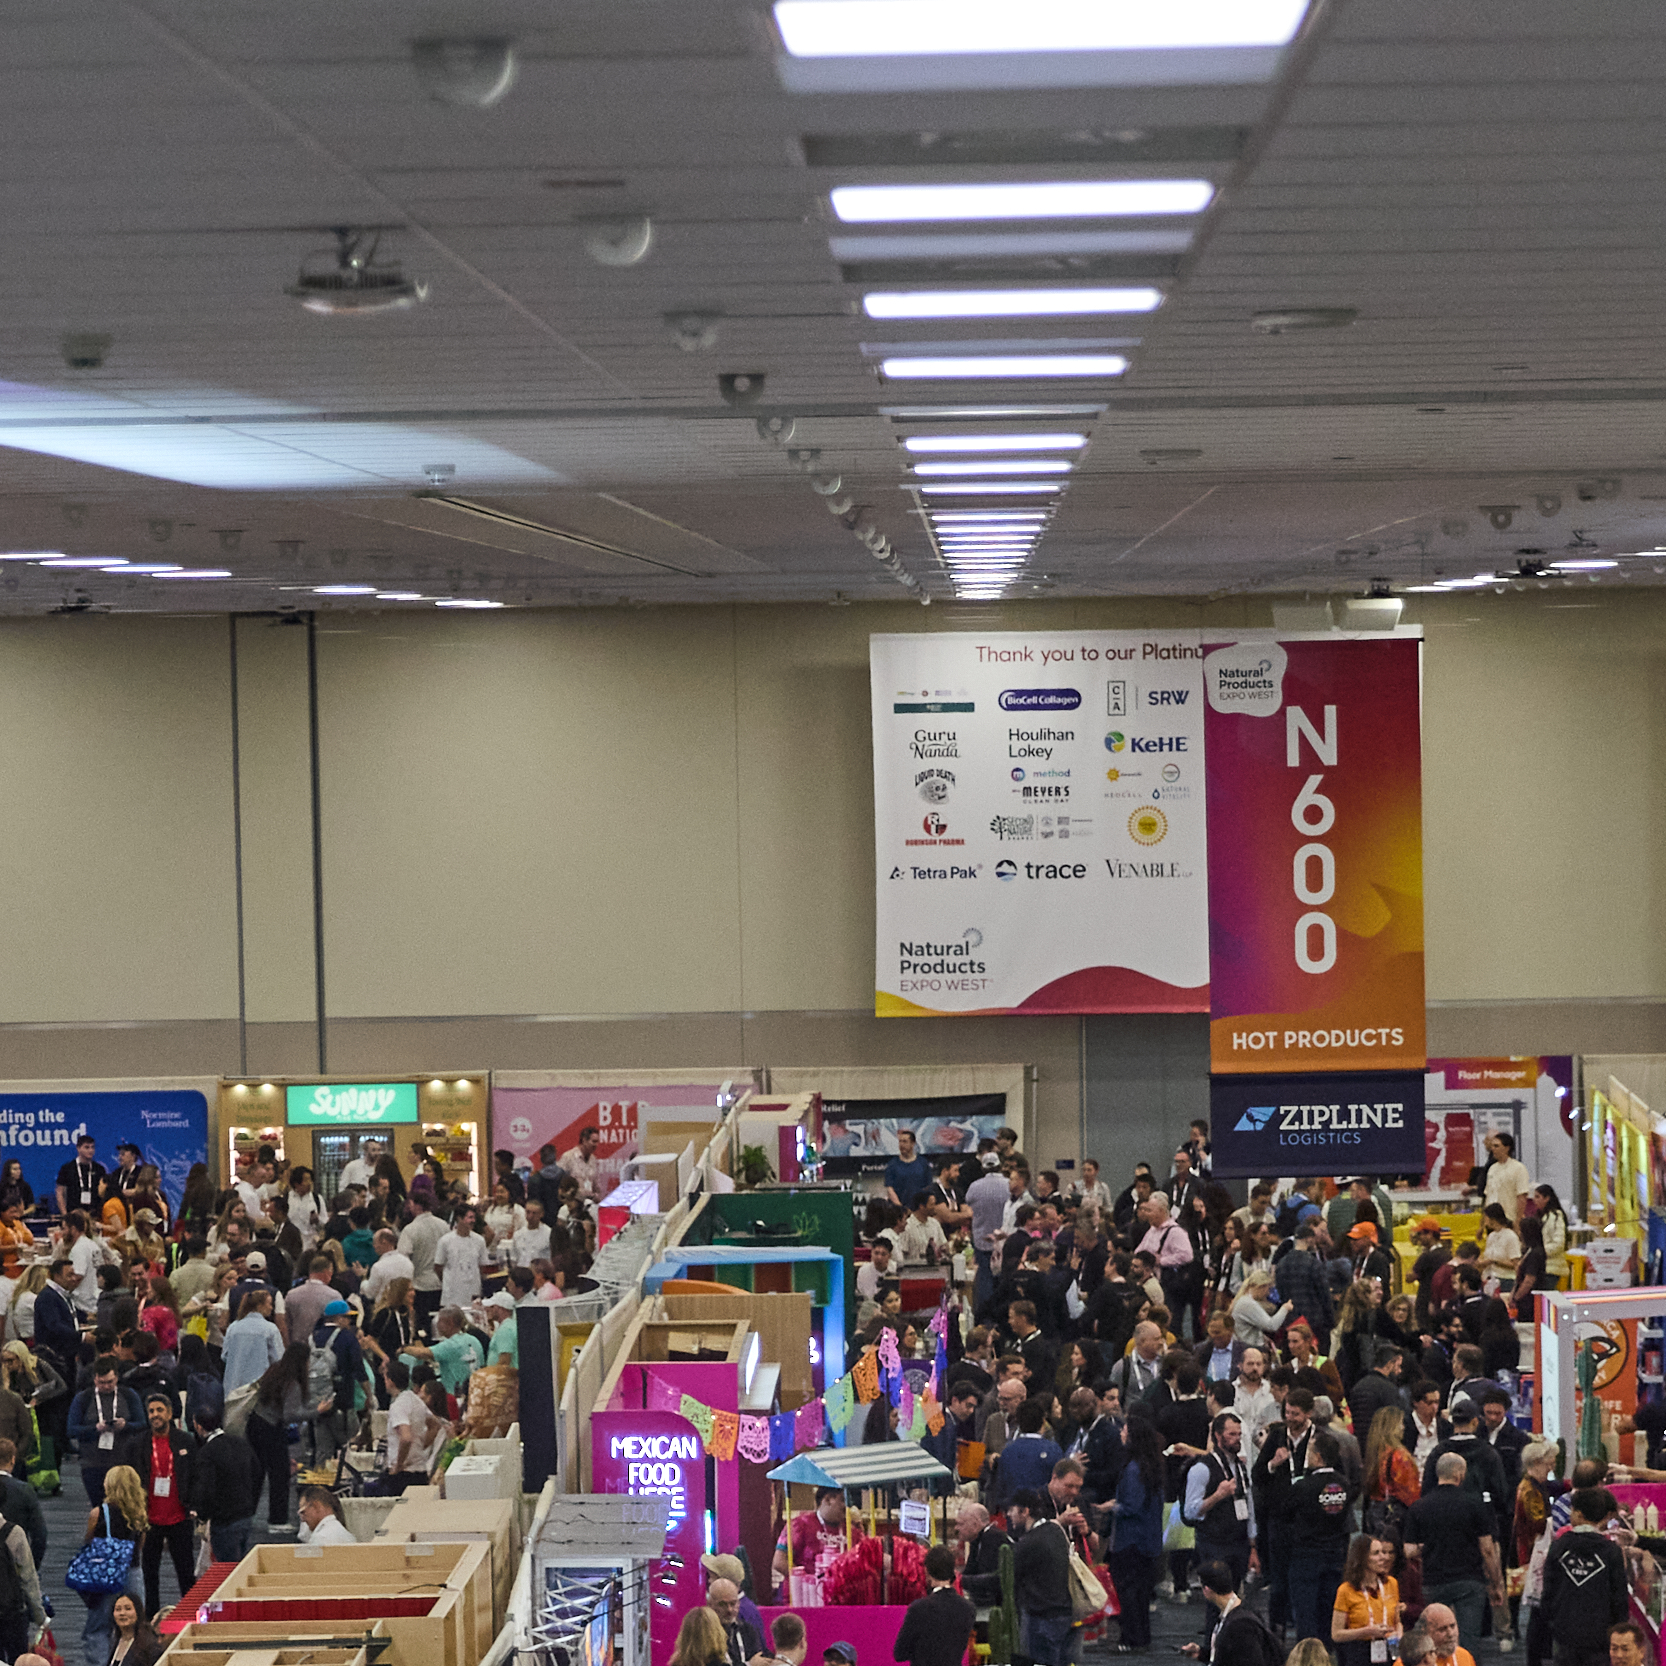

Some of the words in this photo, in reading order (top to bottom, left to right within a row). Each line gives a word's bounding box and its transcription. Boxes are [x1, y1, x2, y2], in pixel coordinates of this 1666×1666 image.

[976, 646, 1033, 662] Thank
[1041, 650, 1074, 666] you
[1082, 646, 1099, 662] to
[1106, 647, 1135, 660] our
[1219, 667, 1264, 680] Natural
[1219, 678, 1274, 690] Products
[1039, 694, 1078, 705] Collagen
[1148, 691, 1189, 705] SRW
[1219, 691, 1245, 699] EXPO
[1247, 691, 1275, 699] WEST
[915, 729, 957, 742] Guru
[1009, 729, 1074, 741] Houlihan
[909, 742, 960, 759] Nanda
[1009, 745, 1052, 759] Lokey
[1131, 737, 1188, 753] KeHE
[915, 770, 934, 787] LIQUID
[936, 769, 956, 785] DEATH
[1033, 769, 1070, 778] method
[1023, 786, 1070, 797] MEYER'S
[911, 867, 947, 879] Tetra
[951, 867, 976, 879] Pak
[1025, 862, 1086, 879] trace
[1105, 860, 1181, 878] VENABLE
[900, 941, 969, 956] Natural
[900, 960, 985, 974] Products
[900, 980, 941, 991] EXPO
[946, 979, 987, 991] WEST
[1233, 1031, 1278, 1050] HOT
[1284, 1028, 1403, 1048] PRODUCTS
[1457, 1069, 1482, 1080] Floor
[1483, 1068, 1527, 1082] Manager
[309, 1086, 396, 1119] SUNNY
[36, 1109, 65, 1123] the
[1279, 1104, 1403, 1130] ZIPLINE
[1280, 1132, 1361, 1145] LOGISTICS
[611, 1436, 697, 1459] MEXICAN
[627, 1462, 681, 1485] FOOD
